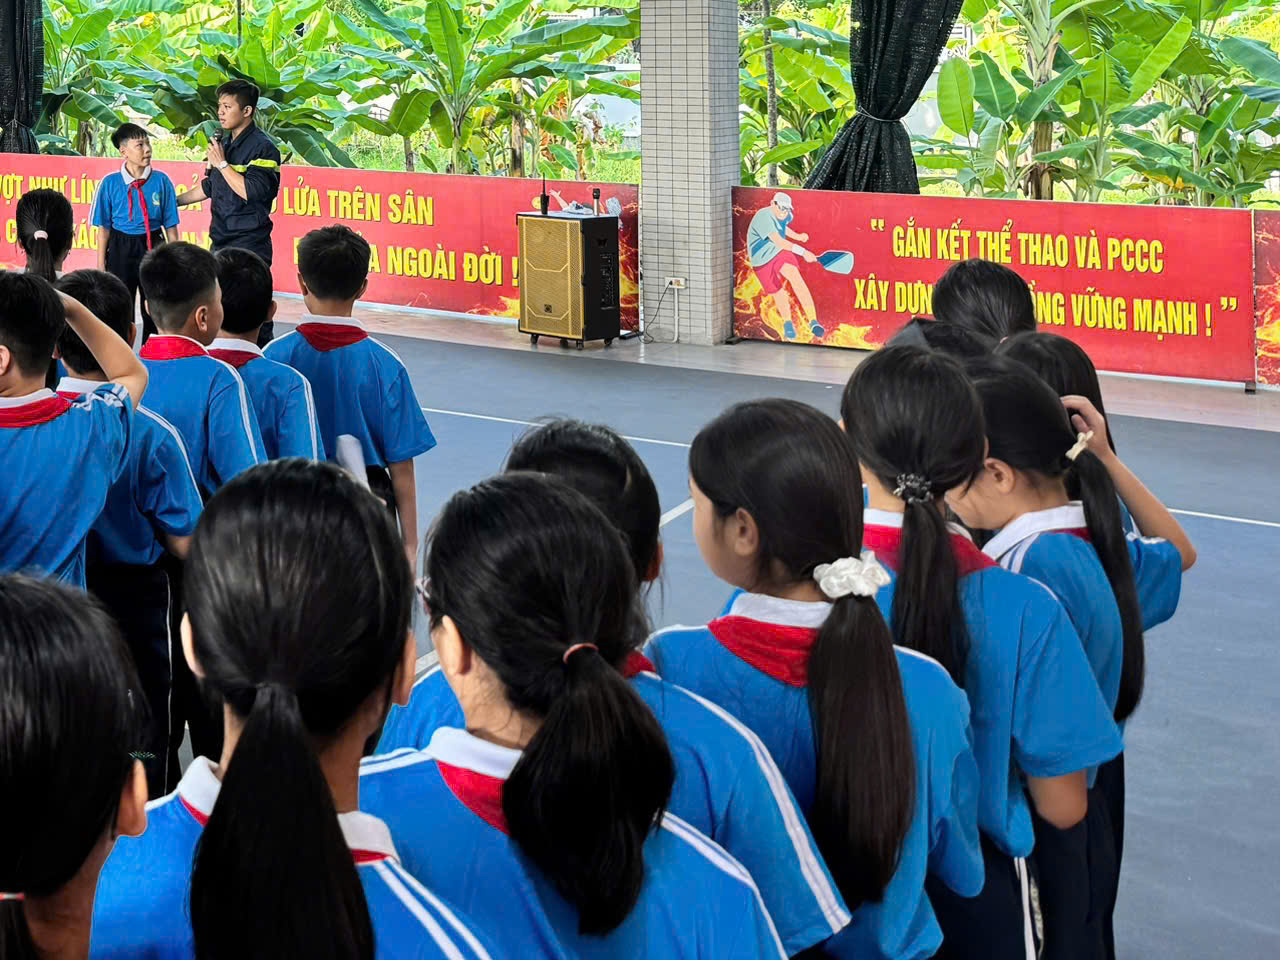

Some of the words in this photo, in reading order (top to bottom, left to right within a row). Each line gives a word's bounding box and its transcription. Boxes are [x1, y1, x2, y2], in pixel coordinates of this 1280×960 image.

[71, 173, 100, 204] LÍN
[283, 176, 321, 217] LỬA
[327, 185, 381, 222] TRÊN
[388, 189, 435, 226] SÂN
[387, 243, 456, 281] NGOÀI
[463, 246, 504, 286] ĐỜI
[892, 216, 931, 259] GẮN
[936, 218, 971, 261] KẾT
[976, 219, 1014, 264] THỂ
[1017, 232, 1069, 268] THAO
[1074, 229, 1102, 270] VÀ
[1107, 237, 1164, 274] PCCC
[854, 273, 890, 312] XÂY
[895, 280, 934, 319] DỰN
[1071, 286, 1127, 331] VỮNG
[1133, 298, 1198, 341] MẠNH
